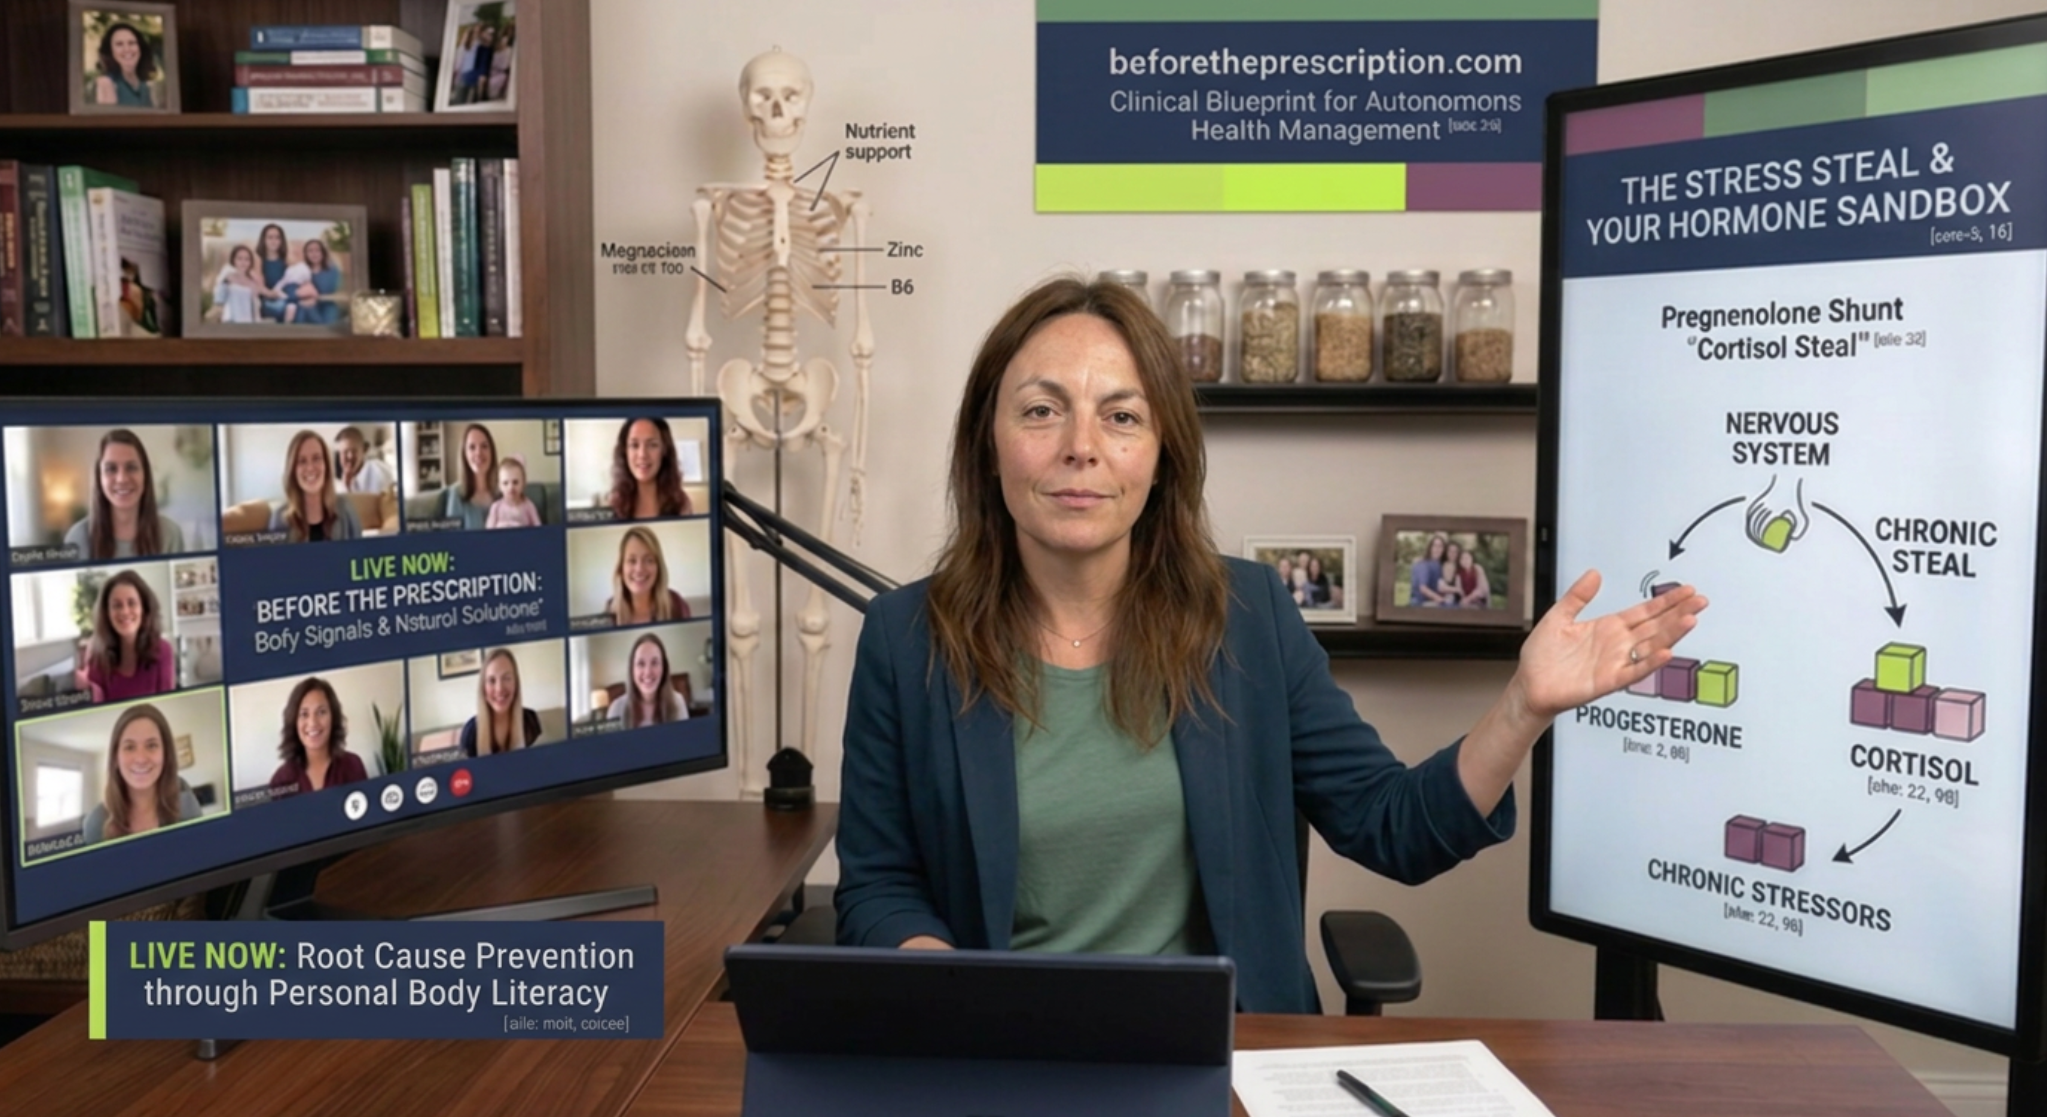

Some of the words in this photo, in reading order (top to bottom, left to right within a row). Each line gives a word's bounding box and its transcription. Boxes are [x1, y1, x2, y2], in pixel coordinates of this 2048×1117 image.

[1109, 47, 1523, 81] beforetheprescription.com
[1110, 90, 1198, 113] Clinical
[1207, 90, 1316, 117] Blueprint
[1323, 90, 1357, 112] for
[1365, 91, 1522, 112] Autonomons
[845, 123, 916, 140] Nutrient
[1191, 119, 1270, 141] Health
[1279, 119, 1441, 145] Management
[845, 144, 912, 163] support
[1621, 172, 1677, 205] THE
[1685, 159, 1803, 199] STRESS
[1812, 146, 1919, 184] STEAL
[1930, 142, 1955, 174] &
[1586, 213, 1661, 246] YOUR
[1669, 198, 1827, 241] HORMONE
[1837, 181, 2012, 227] SANDBOX
[887, 242, 924, 259] Zinc
[891, 280, 914, 295] B6
[1661, 301, 1821, 332] Pregnenolone
[1828, 297, 1904, 322] Shunt
[1795, 331, 1870, 359] Steal"
[1725, 412, 1839, 435] NERVOUS
[1732, 442, 1831, 465] SYSTEM
[1875, 516, 1998, 547] CHRONIC
[351, 555, 396, 581] LIVE
[402, 552, 455, 576] NOW:
[1892, 550, 1977, 578] STEAL
[346, 586, 388, 613] THE
[394, 571, 542, 606] PRESCRIPTION:
[305, 619, 373, 648] Signals
[378, 617, 391, 635] &
[1576, 705, 1743, 749] PROGESTERONE
[1850, 744, 1979, 786] CORTISOL
[1907, 783, 1931, 804] 22,
[1648, 858, 1746, 898] CHRONIC
[1752, 881, 1892, 932] STRESSORS
[1758, 910, 1779, 931] 22,
